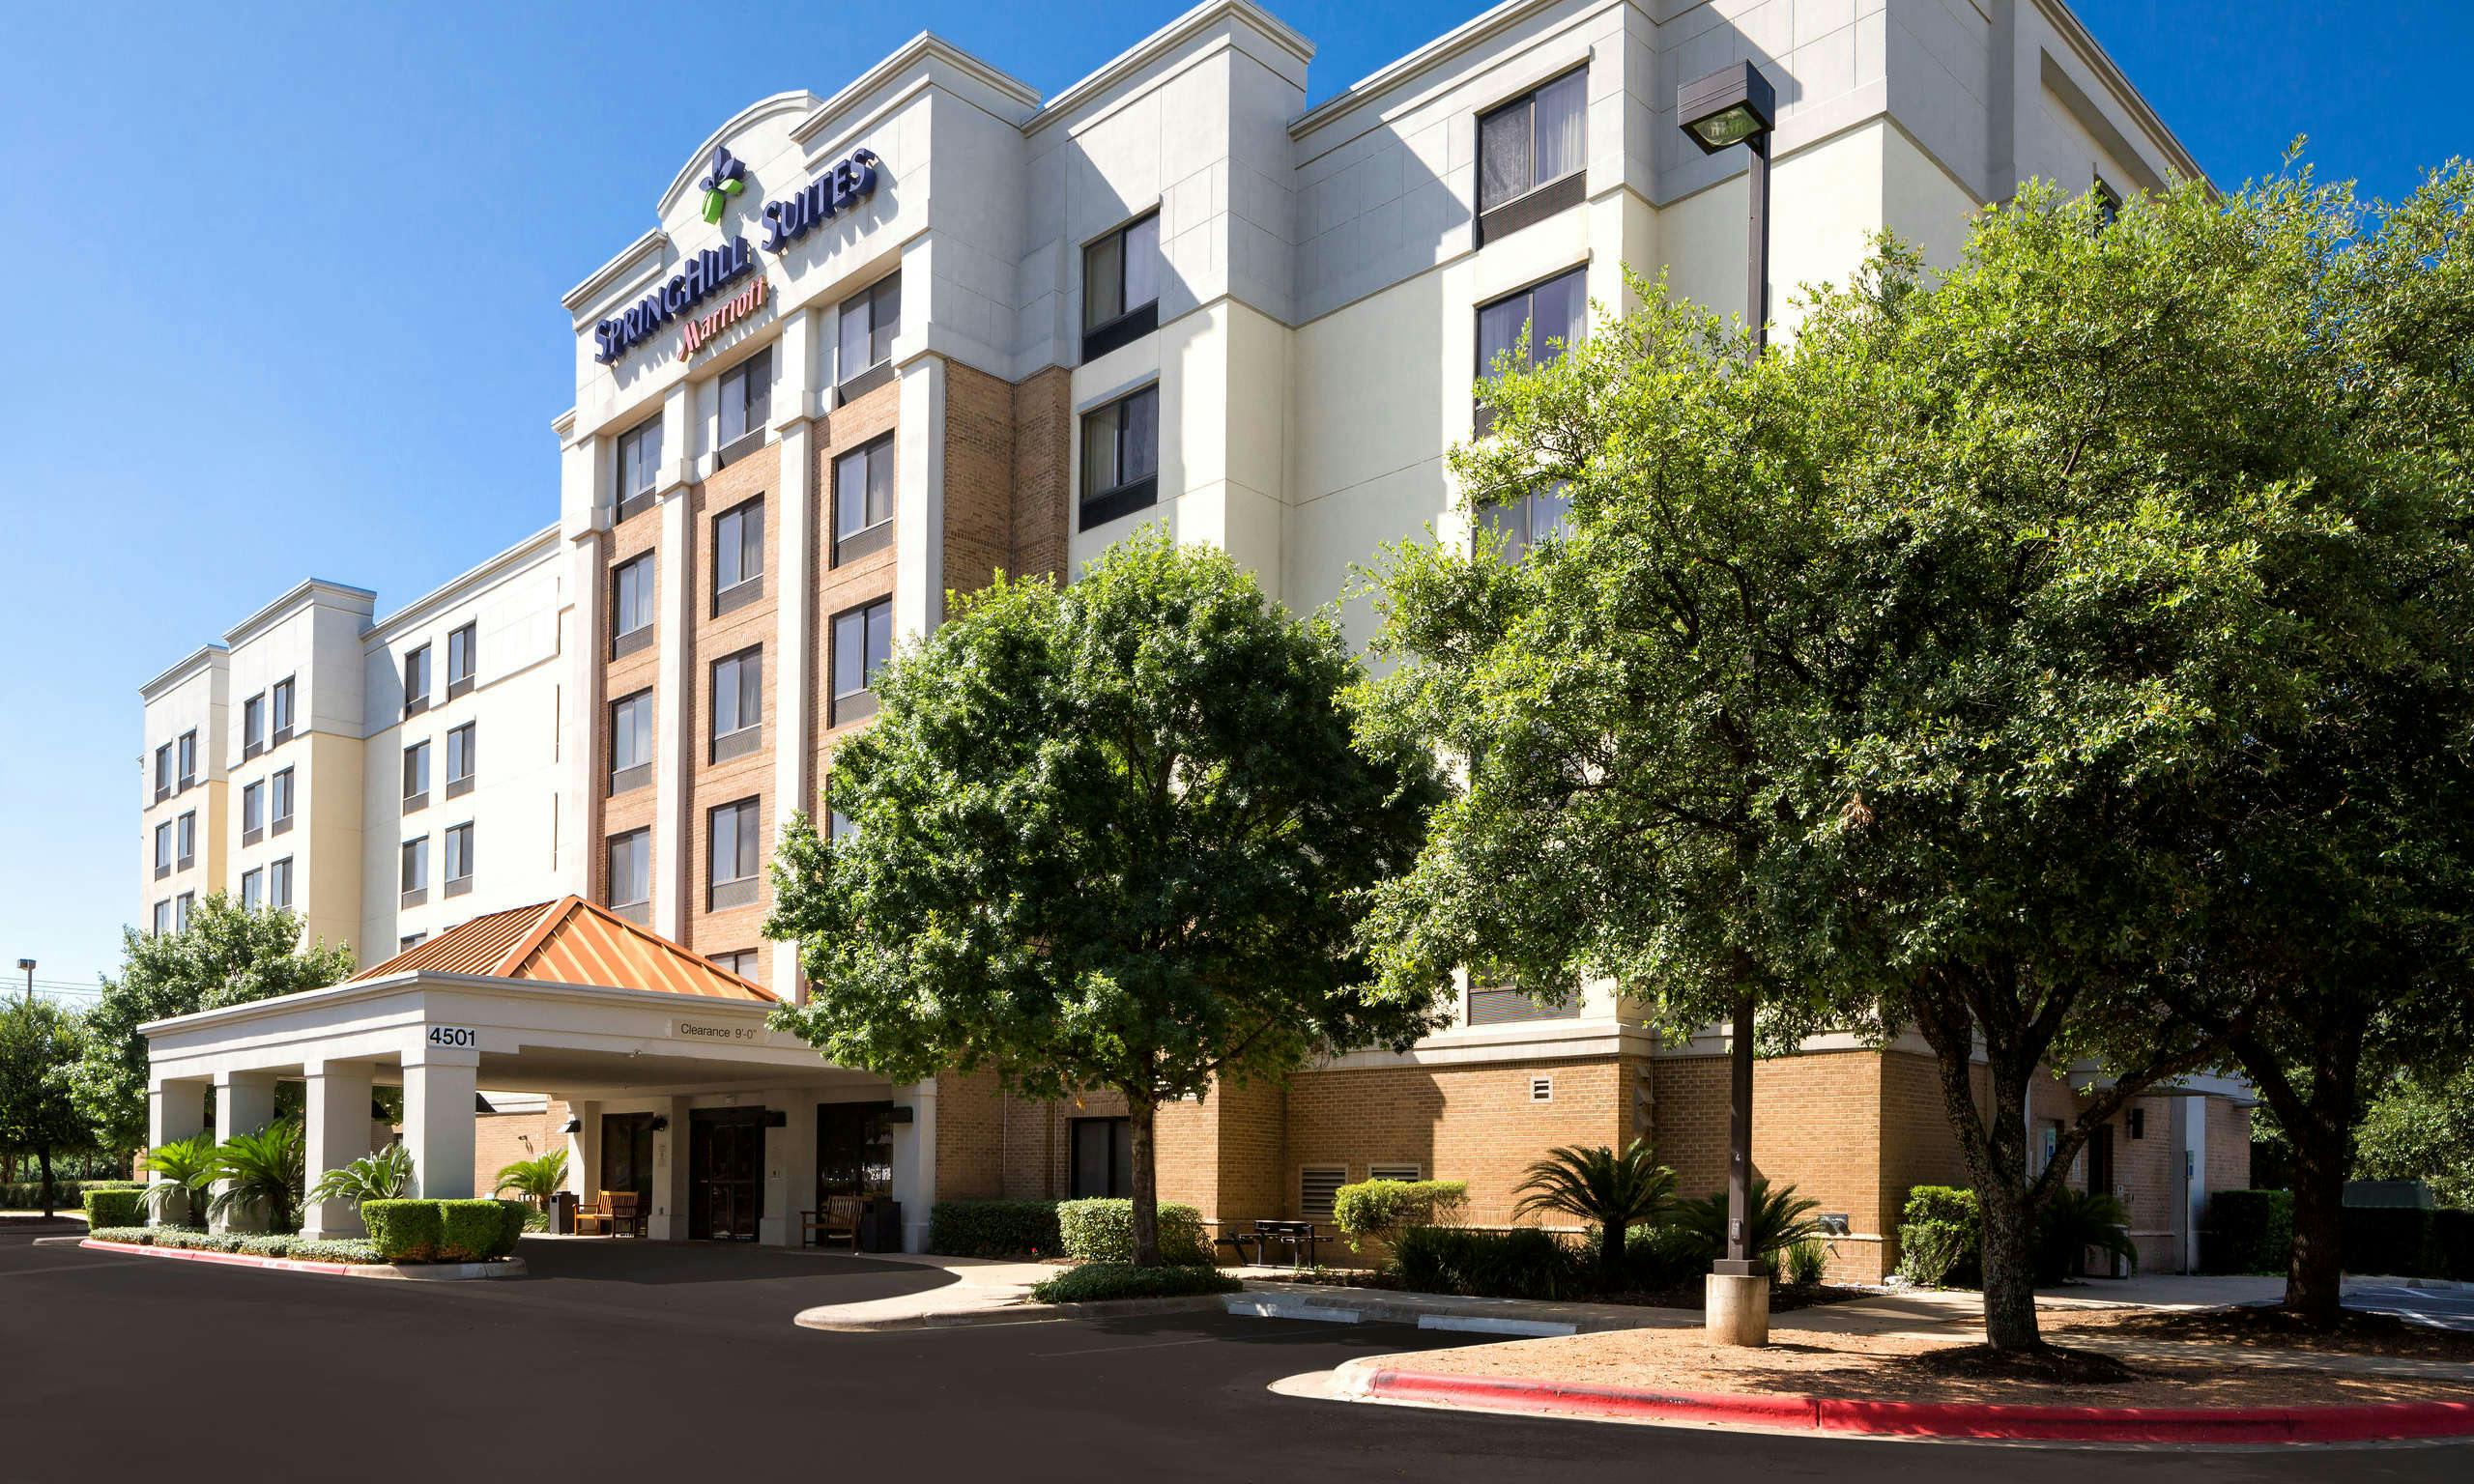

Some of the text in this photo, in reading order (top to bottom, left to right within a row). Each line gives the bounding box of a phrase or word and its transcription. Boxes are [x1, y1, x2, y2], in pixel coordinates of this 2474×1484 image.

[594, 148, 877, 365] SPRINGHILL SUITES
[677, 274, 766, 361] Marriott
[429, 1027, 476, 1046] 4501
[680, 1023, 731, 1038] Clearance
